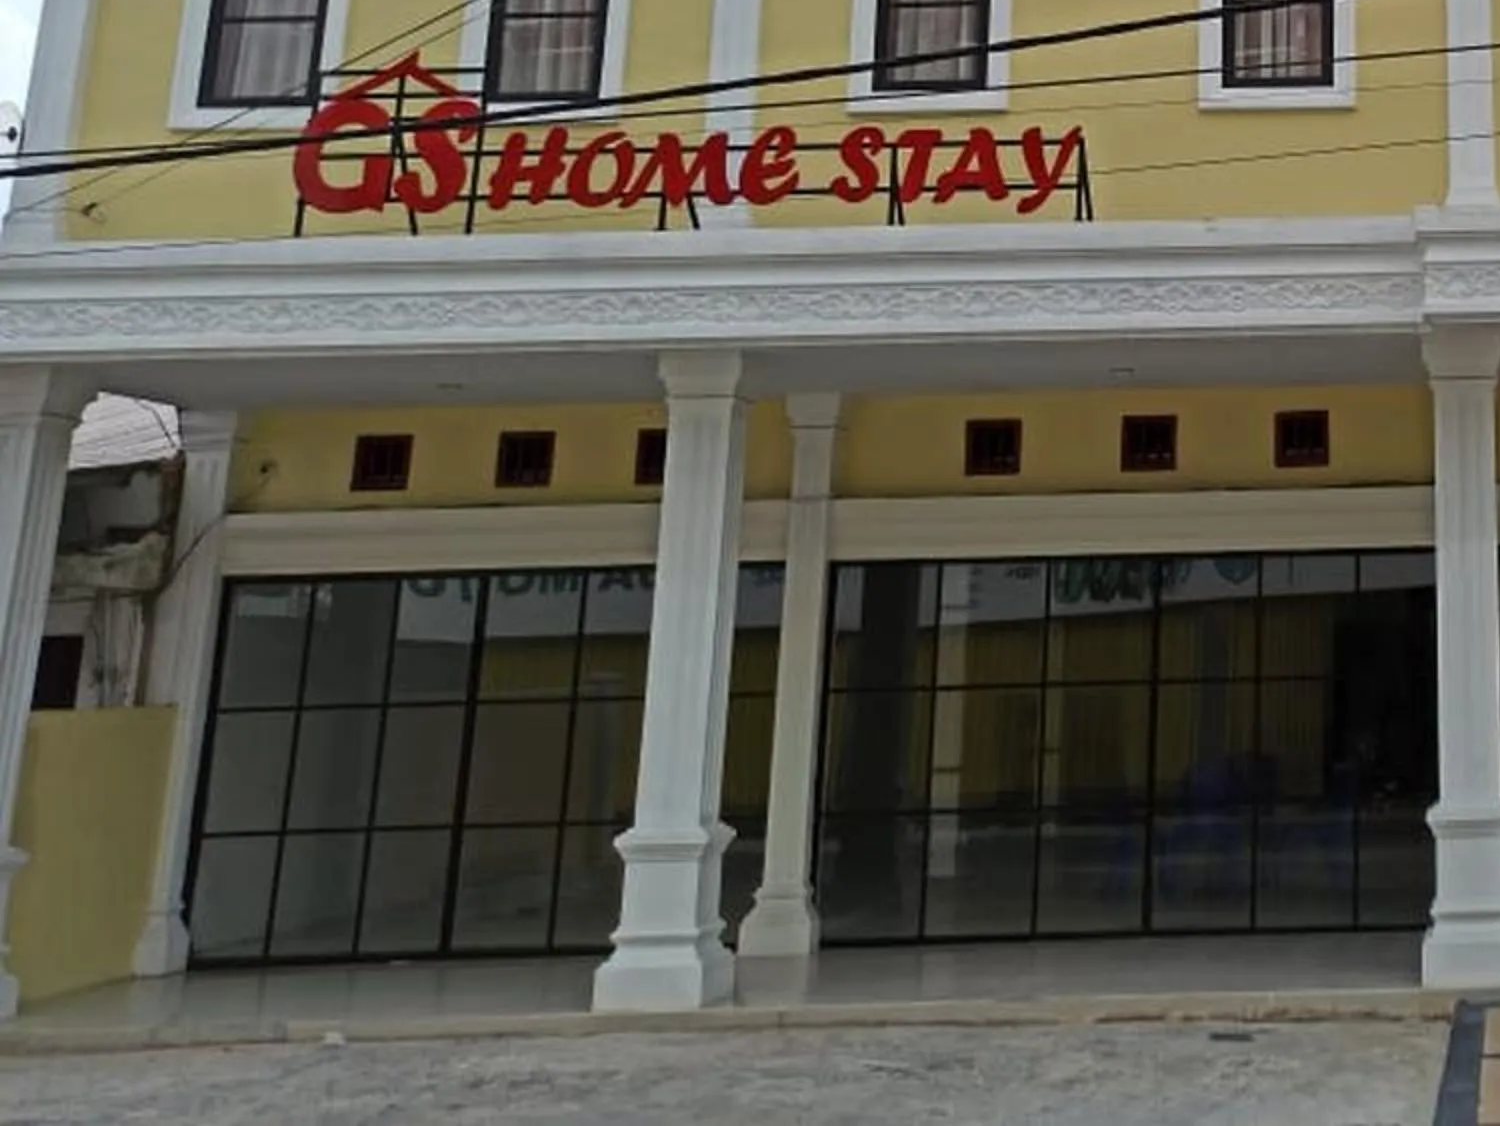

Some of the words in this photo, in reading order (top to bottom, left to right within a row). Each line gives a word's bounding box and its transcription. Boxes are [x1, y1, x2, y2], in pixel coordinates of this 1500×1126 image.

[293, 97, 480, 214] GS
[488, 125, 799, 210] HOME
[830, 124, 1083, 214] STAY
